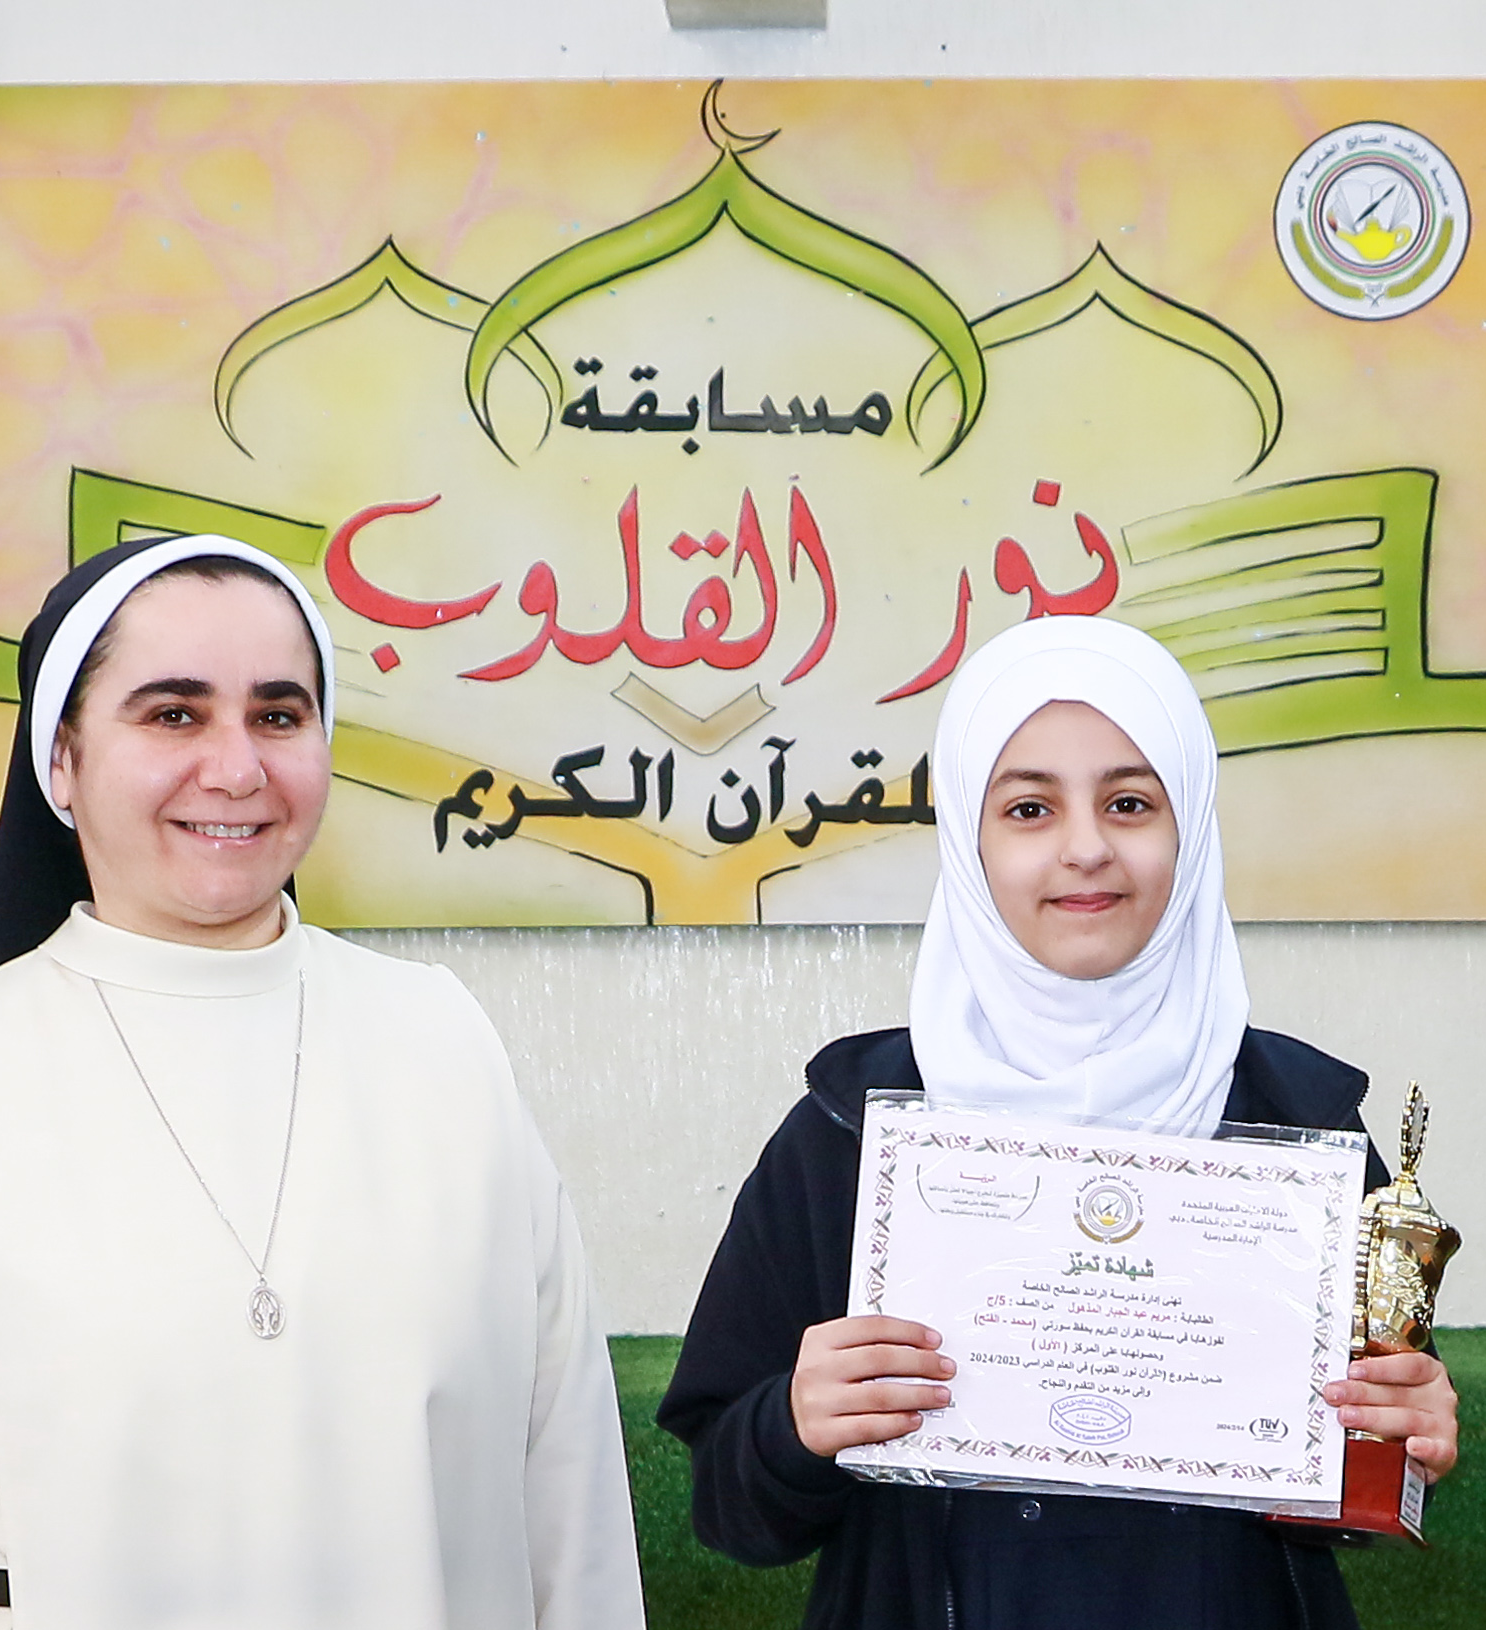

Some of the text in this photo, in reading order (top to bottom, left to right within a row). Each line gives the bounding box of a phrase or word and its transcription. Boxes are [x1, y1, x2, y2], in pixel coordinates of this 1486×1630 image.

[560, 356, 893, 456] مسابقة
[323, 484, 838, 685] القلوب
[432, 735, 937, 854] لقرآن الكريم
[1105, 1255, 1154, 1281] شهادة
[970, 1352, 1021, 1366] 2024/2023
